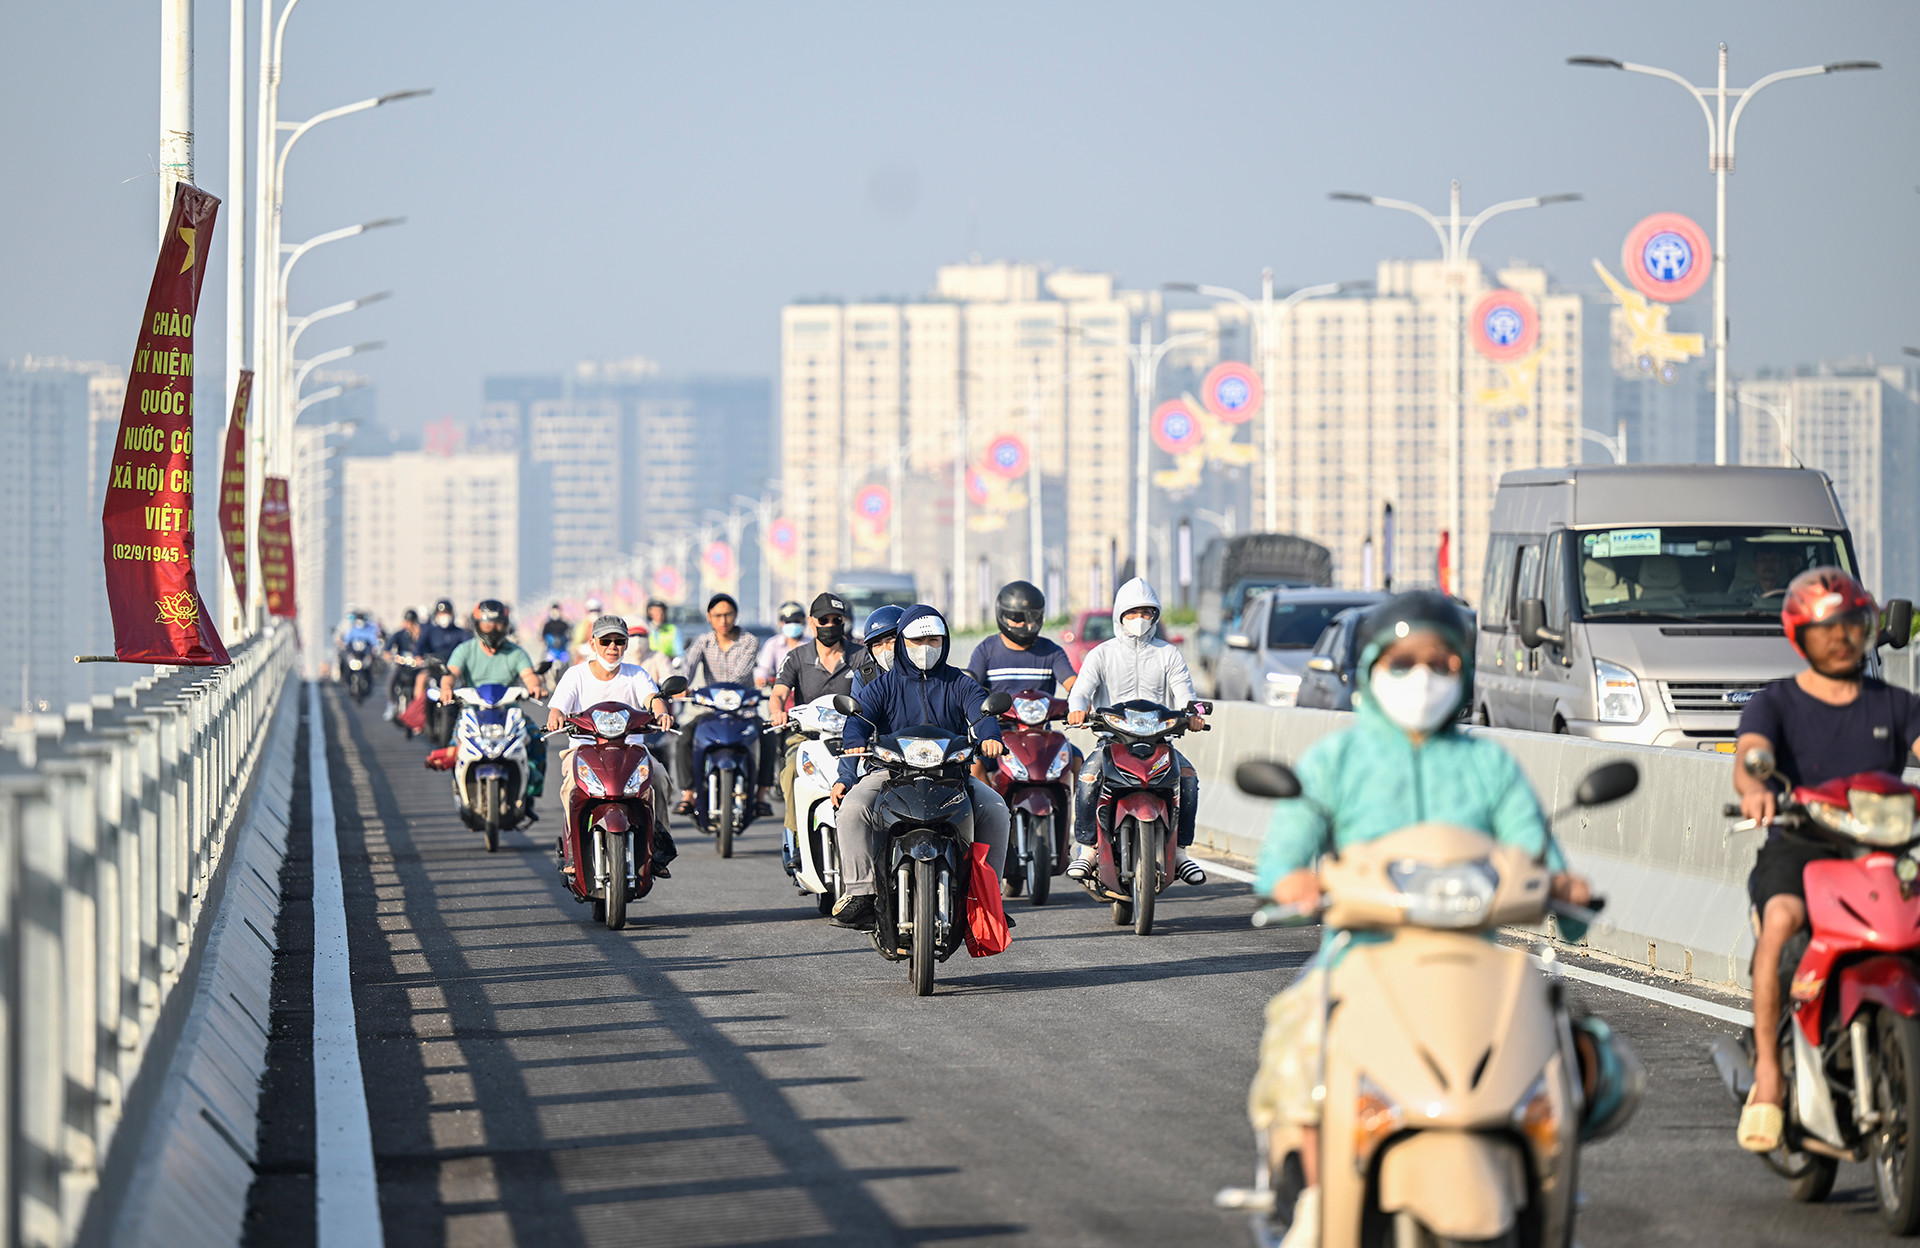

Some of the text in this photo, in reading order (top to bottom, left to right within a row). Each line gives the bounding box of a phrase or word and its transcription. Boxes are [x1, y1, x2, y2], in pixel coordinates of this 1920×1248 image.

[153, 308, 192, 338] CHÀO
[136, 342, 194, 381] KỶ NIỆM
[141, 382, 185, 415] QUỐC
[124, 423, 194, 460] NƯỚC CỘ
[112, 461, 132, 489] XÃ
[136, 463, 164, 497] HỘI
[170, 469, 194, 493] CH
[145, 502, 183, 536] VIỆT
[113, 543, 179, 563] (02/9/1945
